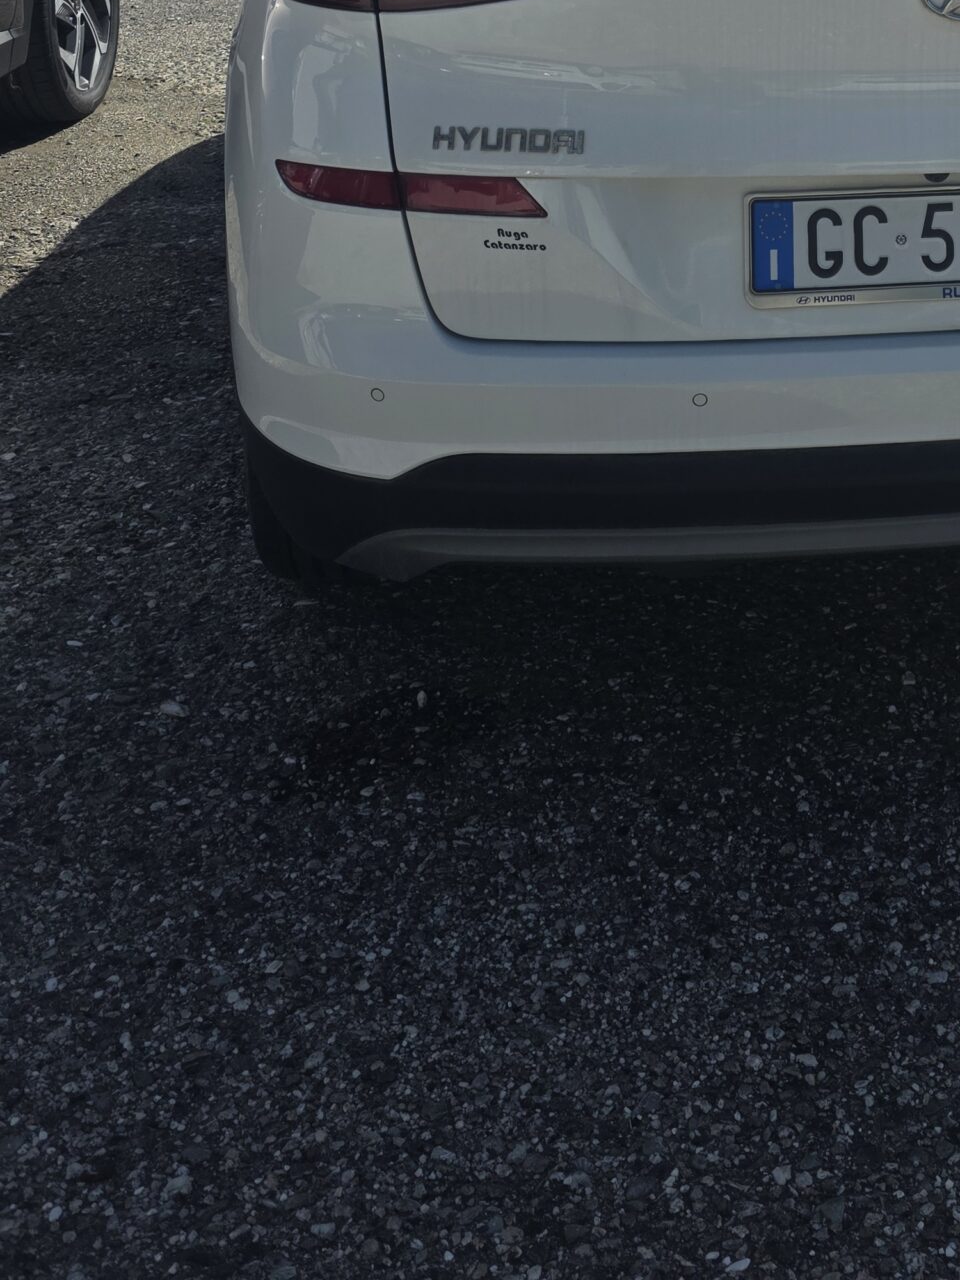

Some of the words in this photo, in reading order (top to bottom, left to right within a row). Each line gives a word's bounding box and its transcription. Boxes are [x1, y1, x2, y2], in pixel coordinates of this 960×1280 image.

[431, 125, 585, 155] HYUNDAI
[497, 228, 529, 241] Ruga
[483, 239, 547, 251] Catanzaro
[813, 294, 856, 304] HYUNDAI
